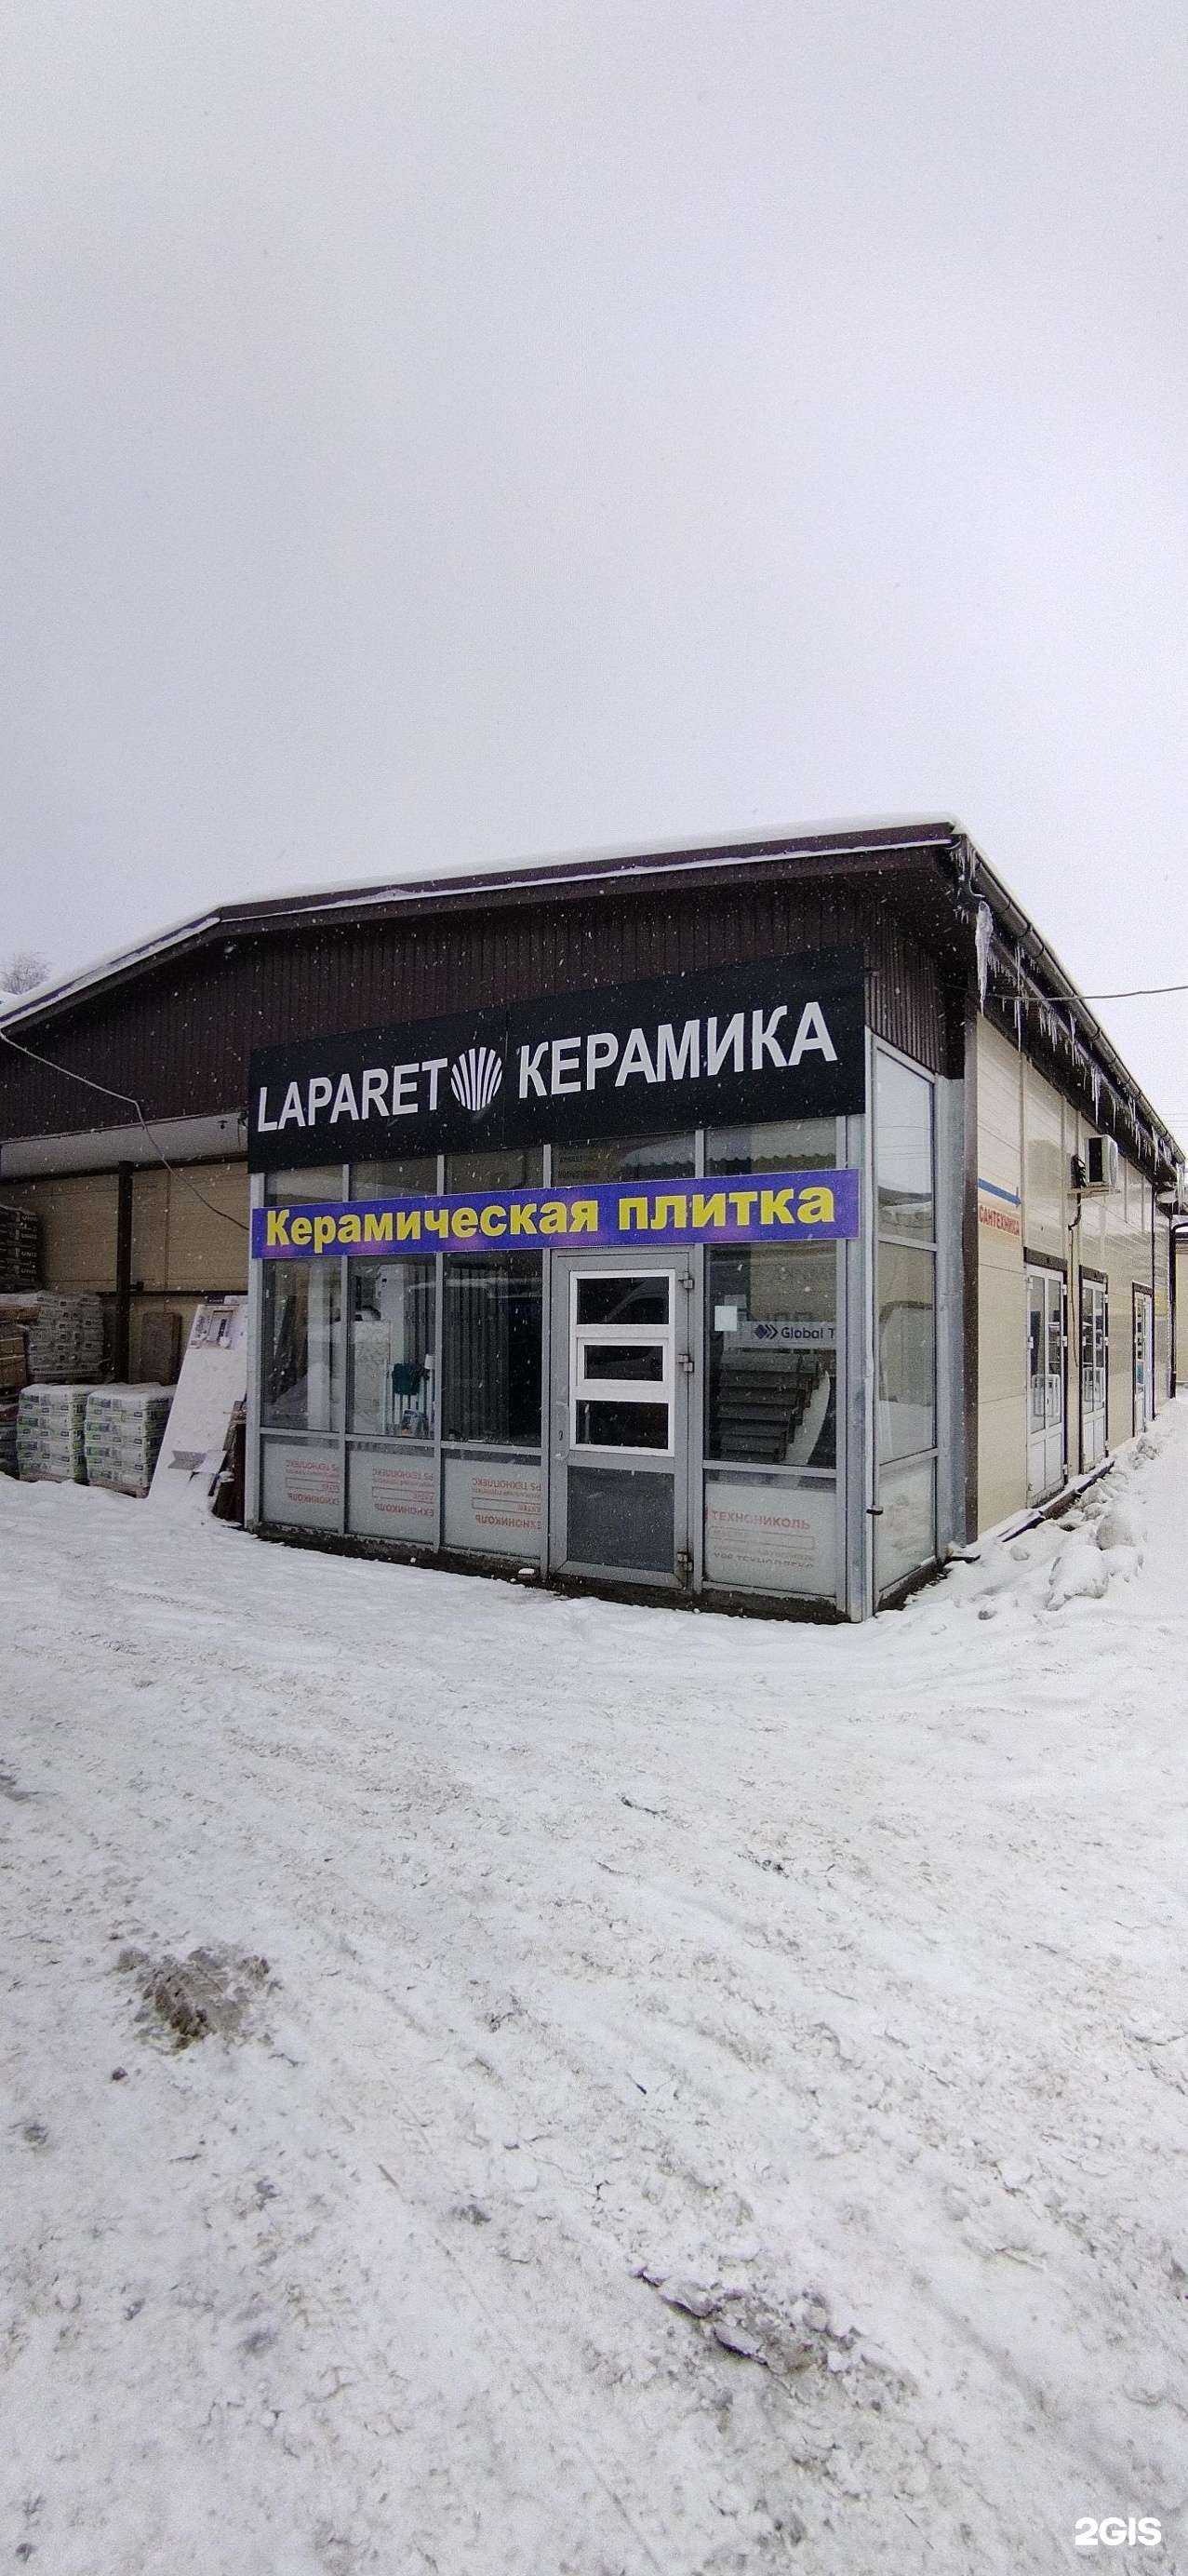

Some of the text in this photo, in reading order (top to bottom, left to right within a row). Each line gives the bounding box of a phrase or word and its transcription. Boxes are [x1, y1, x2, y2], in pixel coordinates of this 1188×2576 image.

[258, 1001, 838, 1133] LAPARET КЕРАМИКА
[266, 1187, 834, 1254] Керамическая плитка
[781, 1326, 823, 1339] Global
